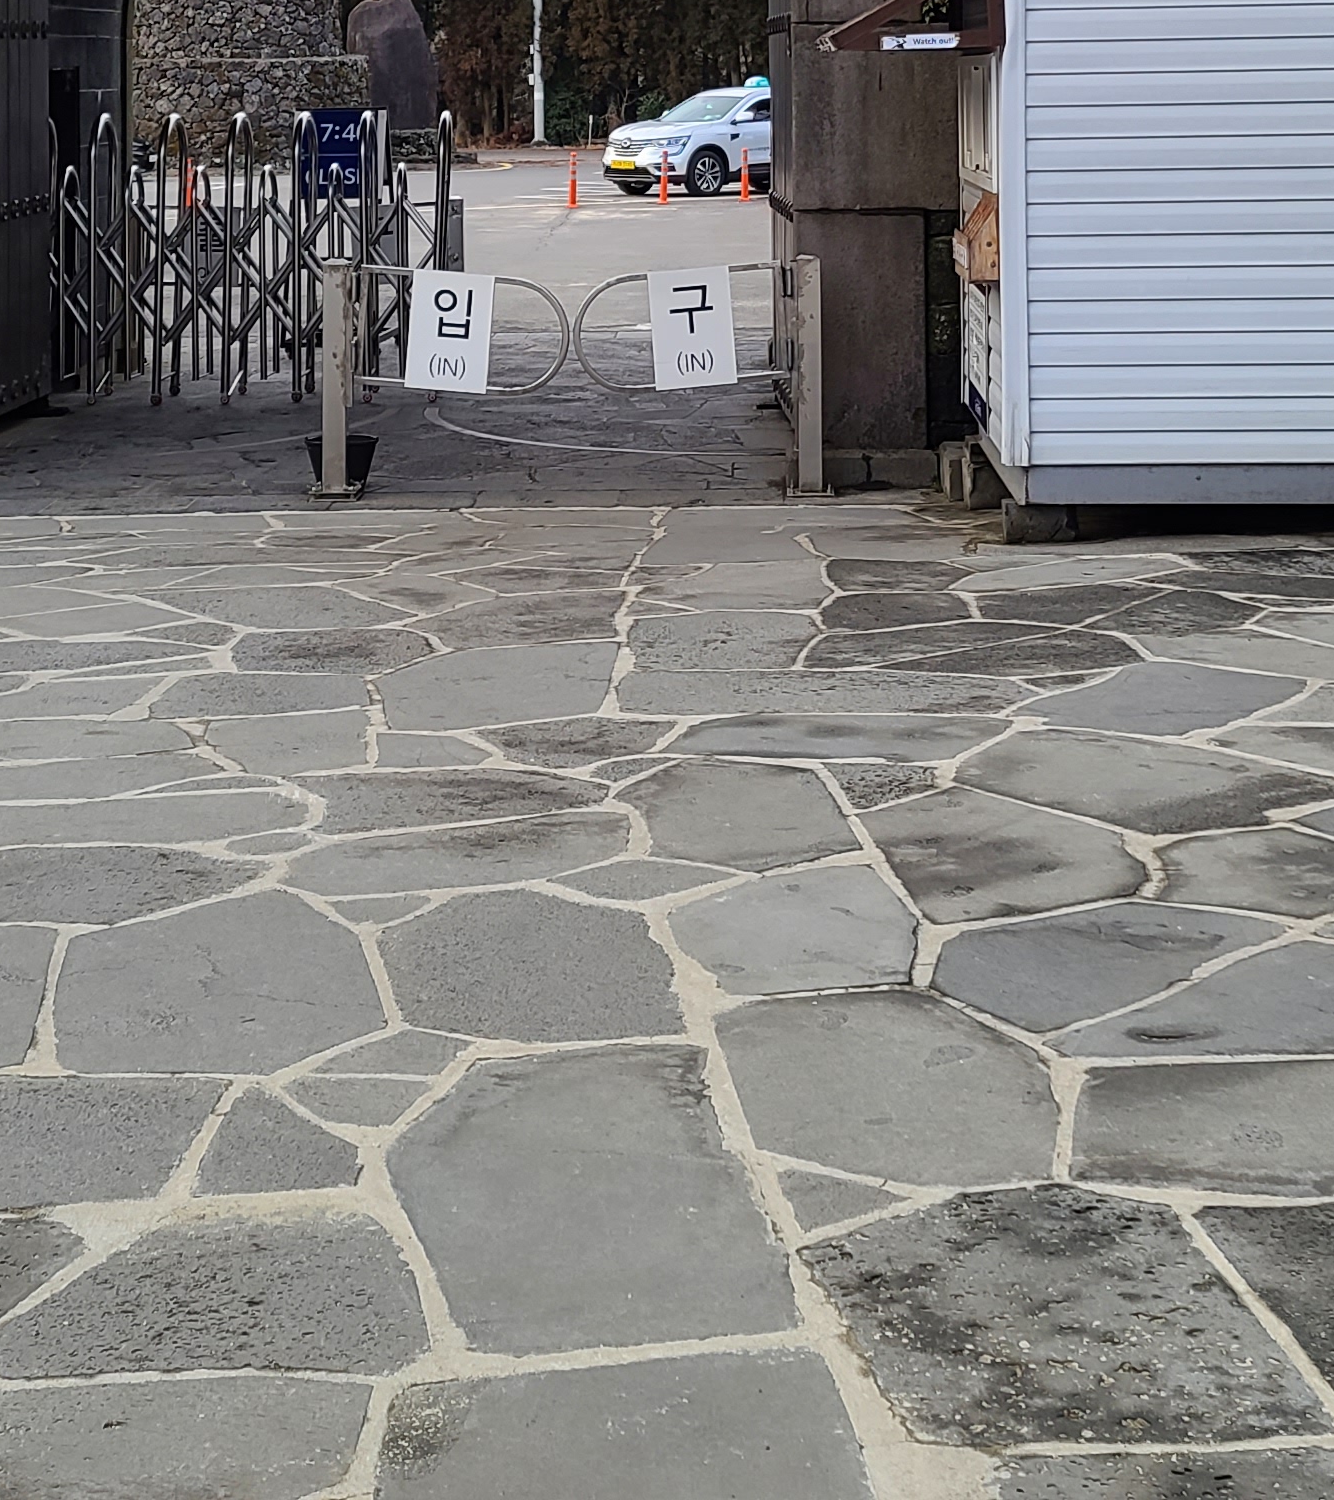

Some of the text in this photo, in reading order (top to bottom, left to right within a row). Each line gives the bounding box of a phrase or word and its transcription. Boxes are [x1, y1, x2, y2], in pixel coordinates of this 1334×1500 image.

[320, 123, 359, 142] 7:4
[434, 289, 473, 339] 입
[669, 285, 714, 334] 구
[429, 353, 466, 380] (IN)
[676, 349, 714, 376] (IN)
